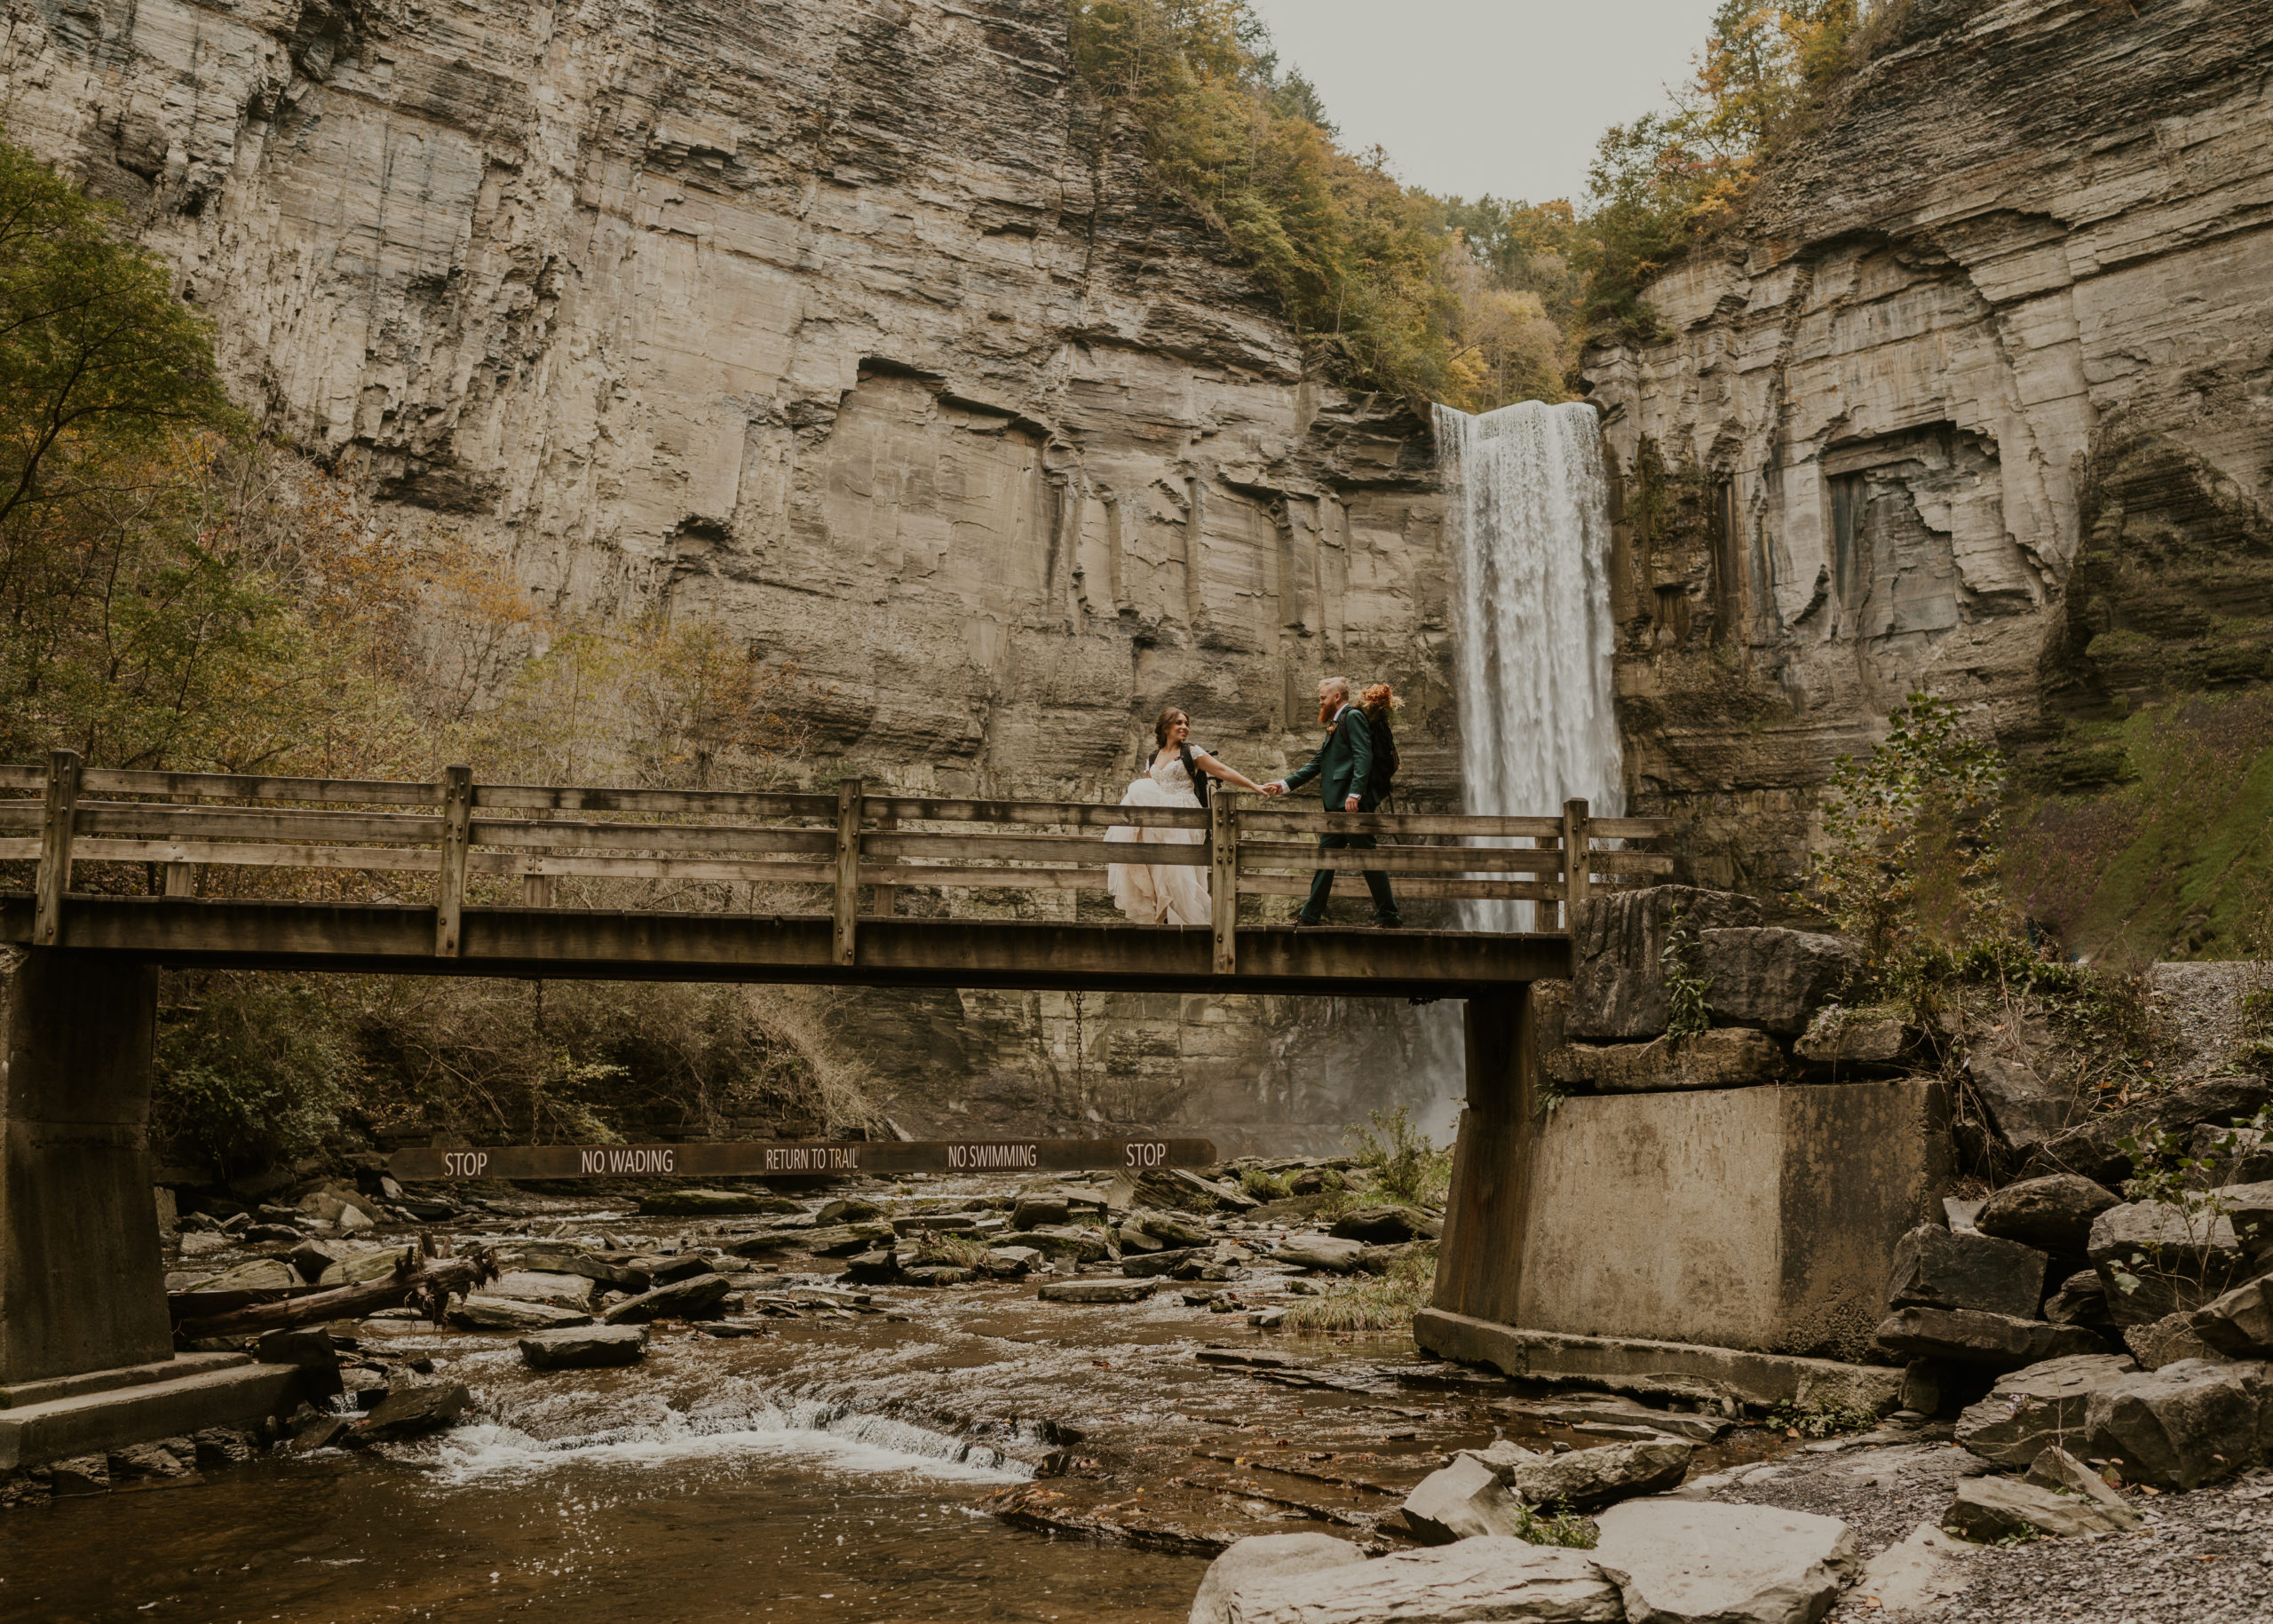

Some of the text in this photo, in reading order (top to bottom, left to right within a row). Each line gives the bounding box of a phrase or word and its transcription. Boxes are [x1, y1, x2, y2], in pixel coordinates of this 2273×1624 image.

[444, 1152, 487, 1176] STOP
[582, 1149, 673, 1174] NO WADING
[766, 1147, 859, 1170] RETURN TO TRAIL
[948, 1145, 1036, 1168] NO SWIMMING
[1126, 1143, 1166, 1167] STOP
